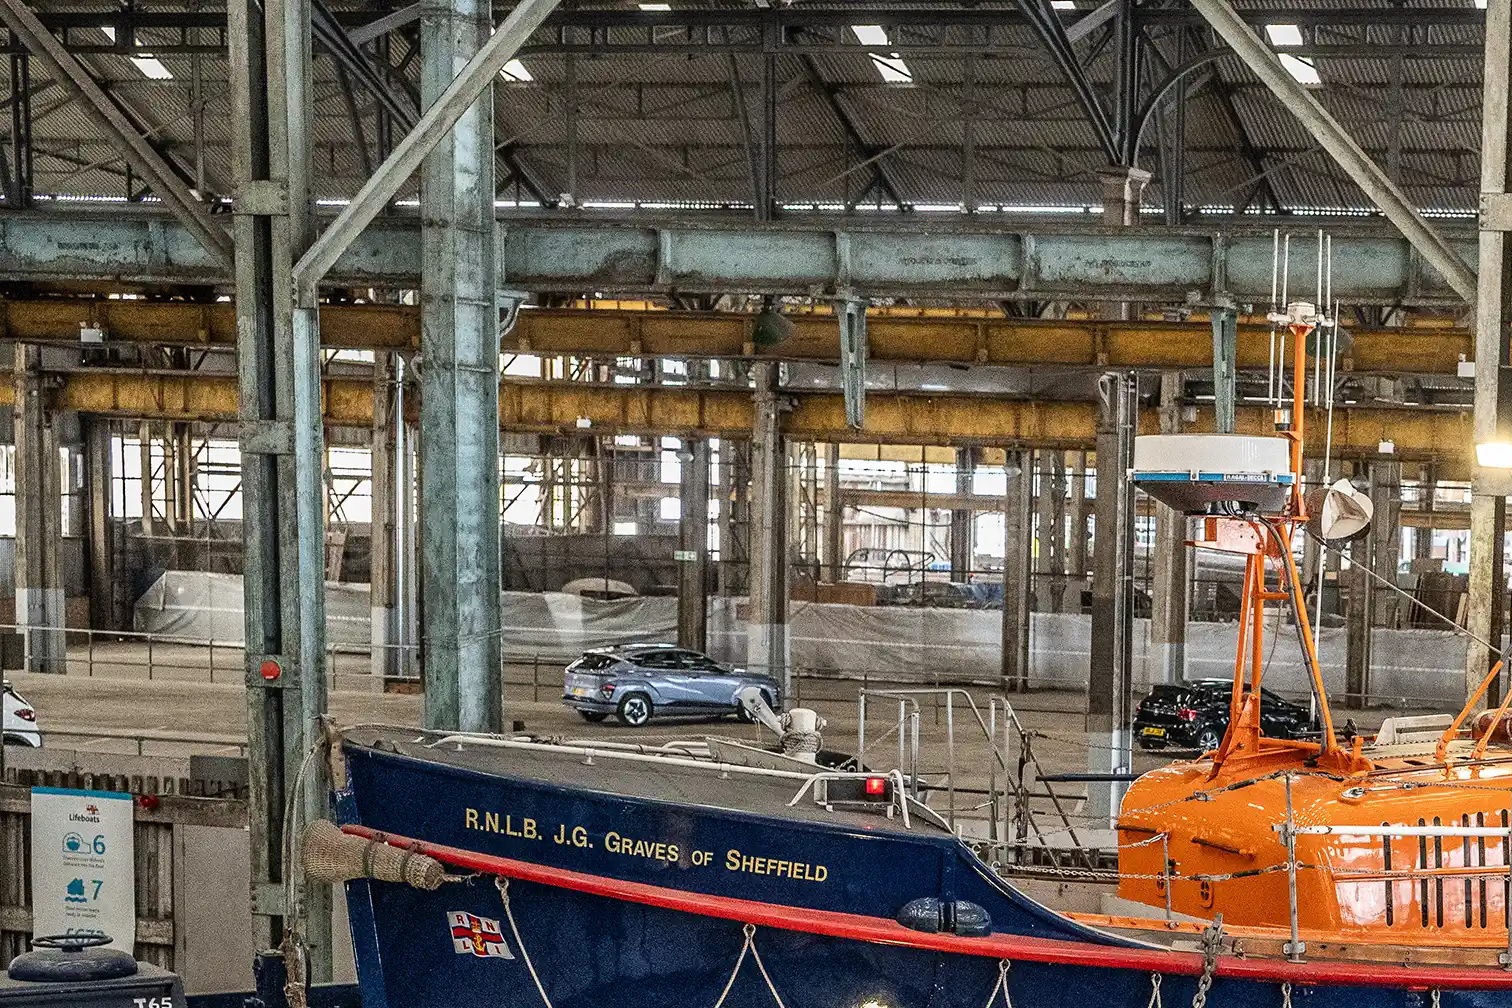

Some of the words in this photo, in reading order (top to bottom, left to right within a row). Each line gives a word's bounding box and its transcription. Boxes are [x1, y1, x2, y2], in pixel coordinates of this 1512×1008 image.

[69, 813, 100, 824] Lifeboats
[465, 807, 543, 841] R.N.L.B.
[553, 823, 594, 849] J.G.
[92, 833, 106, 856] 6
[91, 878, 104, 901] 7
